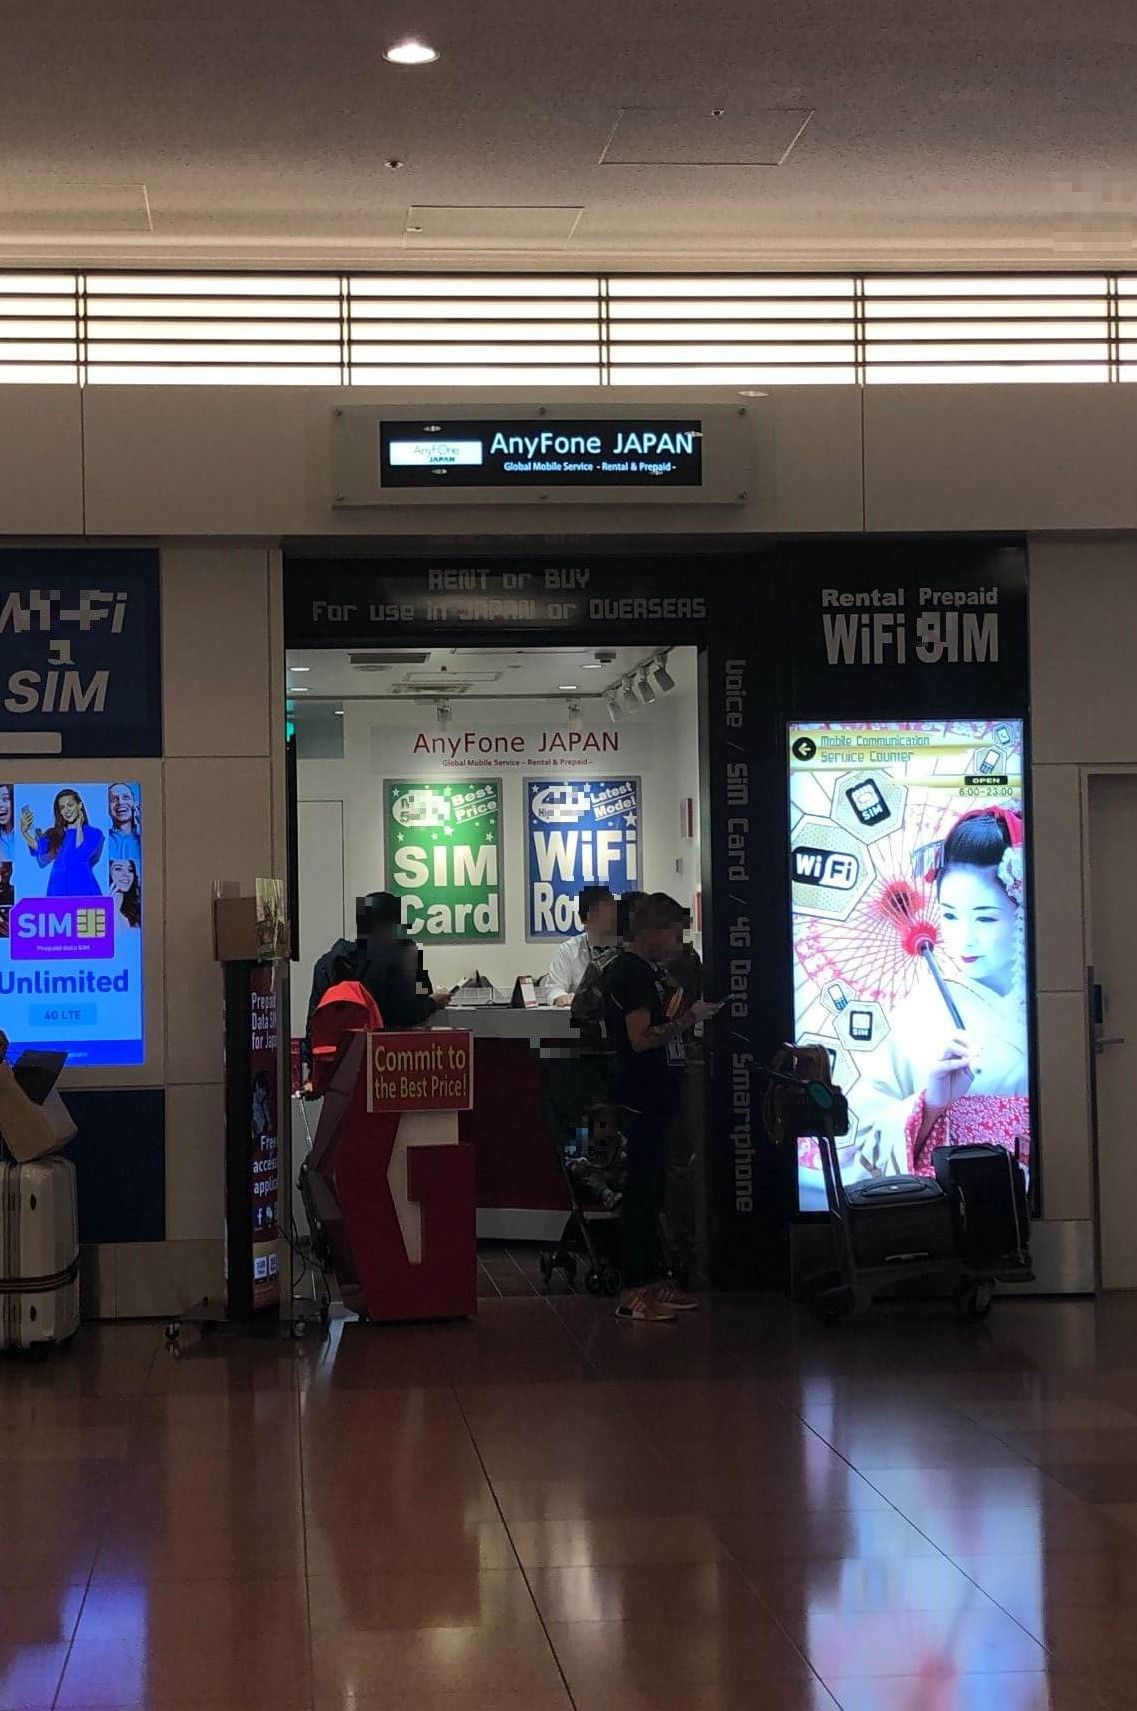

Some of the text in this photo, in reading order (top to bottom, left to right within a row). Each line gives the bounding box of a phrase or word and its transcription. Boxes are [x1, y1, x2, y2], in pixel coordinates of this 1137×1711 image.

[490, 432, 693, 459] AnyFone JAPAN
[504, 462, 532, 471] Global
[533, 462, 562, 471] Mobile
[563, 462, 593, 471] Service
[602, 461, 629, 471] Rental
[630, 462, 638, 471] &
[639, 461, 671, 474] Prepaid
[429, 568, 590, 590] RENT or BUY
[822, 587, 999, 609] Rental Prepaid
[312, 600, 358, 622] For
[369, 604, 415, 621] use
[548, 602, 577, 620] or
[589, 598, 706, 619] OVERSEAS
[822, 613, 906, 665] WiFi
[4, 669, 110, 714] SIM
[413, 731, 619, 758] AnyFone JAPAN
[821, 735, 930, 747] Mobile Communication
[442, 759, 466, 767] Global
[467, 759, 493, 767] Mobile
[494, 759, 520, 767] Service
[527, 758, 551, 766] Rental
[560, 758, 588, 768] Prepaid
[821, 751, 914, 763] Service Counter
[451, 785, 495, 805] Best
[590, 782, 633, 804] Latest
[454, 801, 497, 822] Price
[594, 795, 637, 818] Model
[861, 803, 884, 821] SIM
[533, 830, 637, 881] WiFi
[728, 817, 749, 881] Card
[394, 845, 498, 888] SIM
[17, 912, 72, 938] SIM
[401, 893, 499, 934] Card
[0, 969, 129, 995] Unlimited
[61, 1010, 82, 1019] LTE
[252, 1012, 269, 1031] Data
[252, 1031, 264, 1050] for
[375, 1043, 466, 1072] Commit to
[375, 1073, 467, 1099] the Best Price!
[730, 1052, 754, 1213] Smartphone
